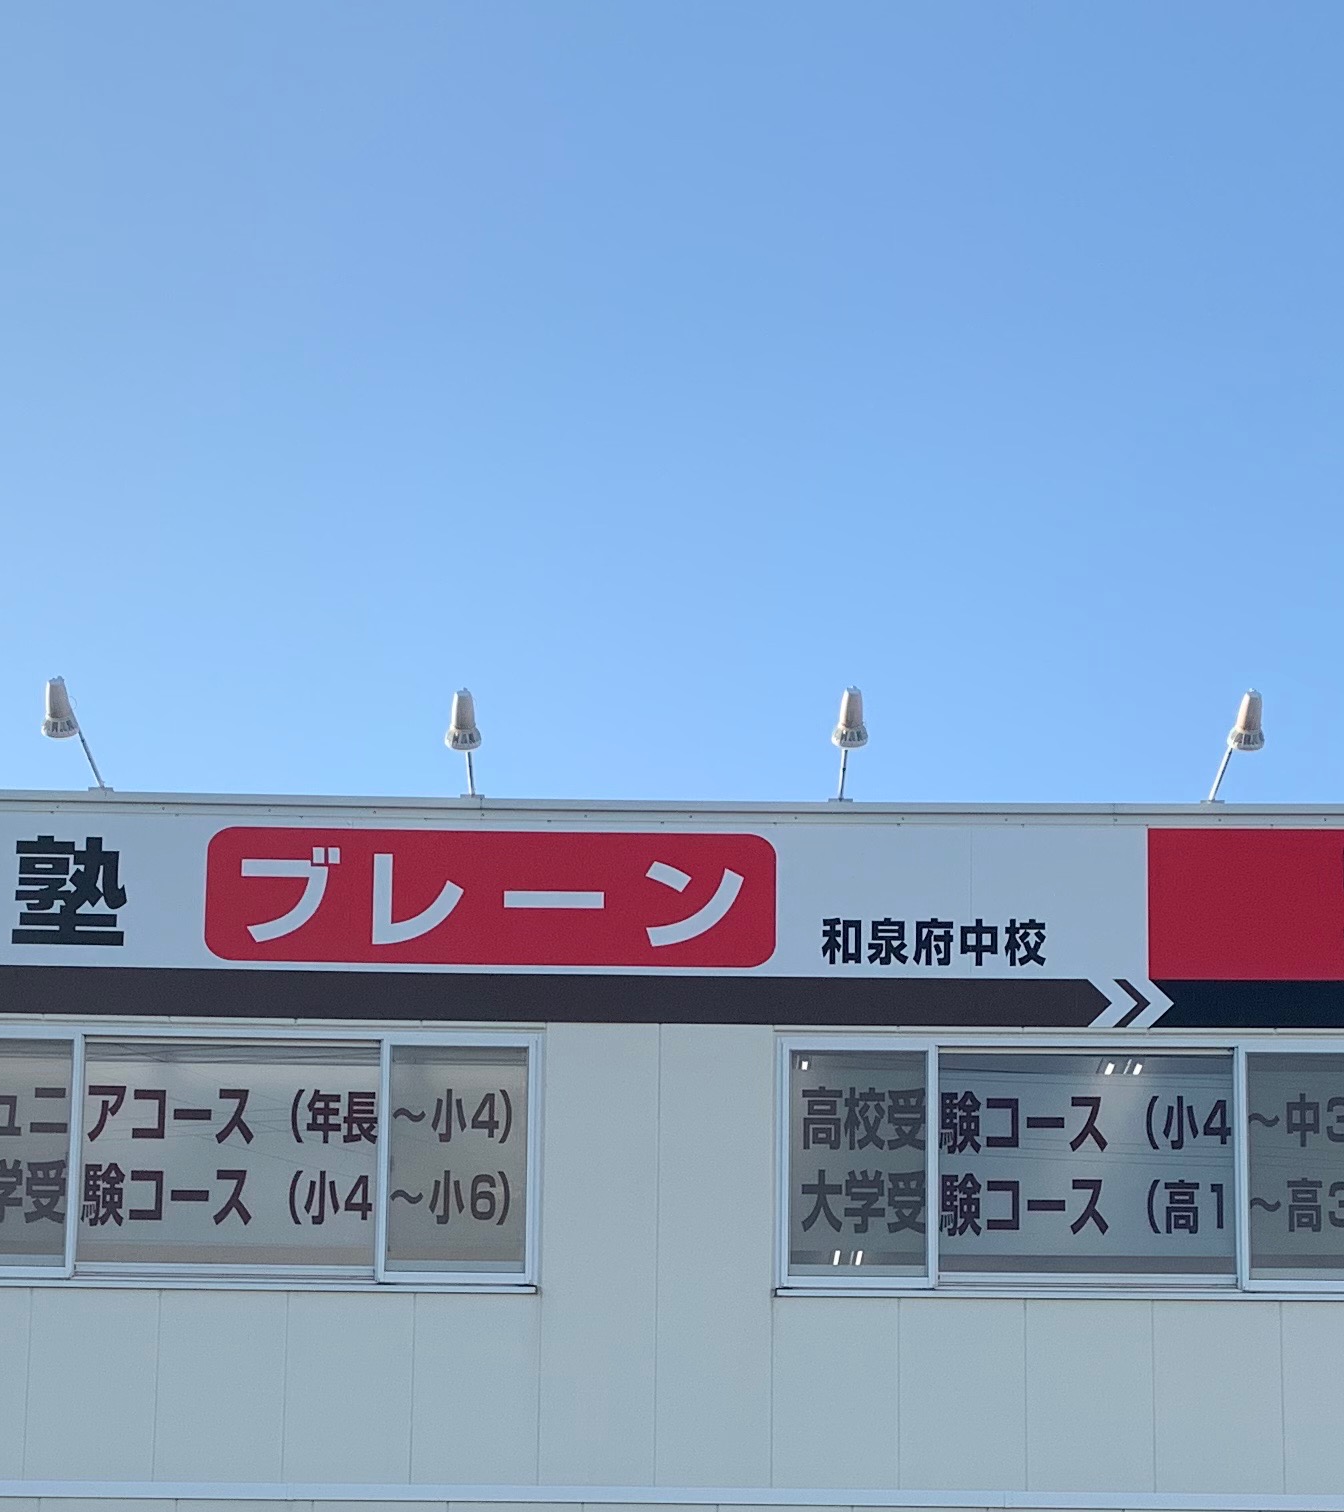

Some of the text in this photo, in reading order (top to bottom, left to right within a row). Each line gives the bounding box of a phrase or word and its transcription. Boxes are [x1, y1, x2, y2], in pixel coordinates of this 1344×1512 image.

[240, 846, 744, 947] ブレーン
[821, 917, 1047, 967] 和泉府中校
[801, 1086, 1109, 1155] 高校受験コース
[800, 1168, 1109, 1237] 大学受験コース
